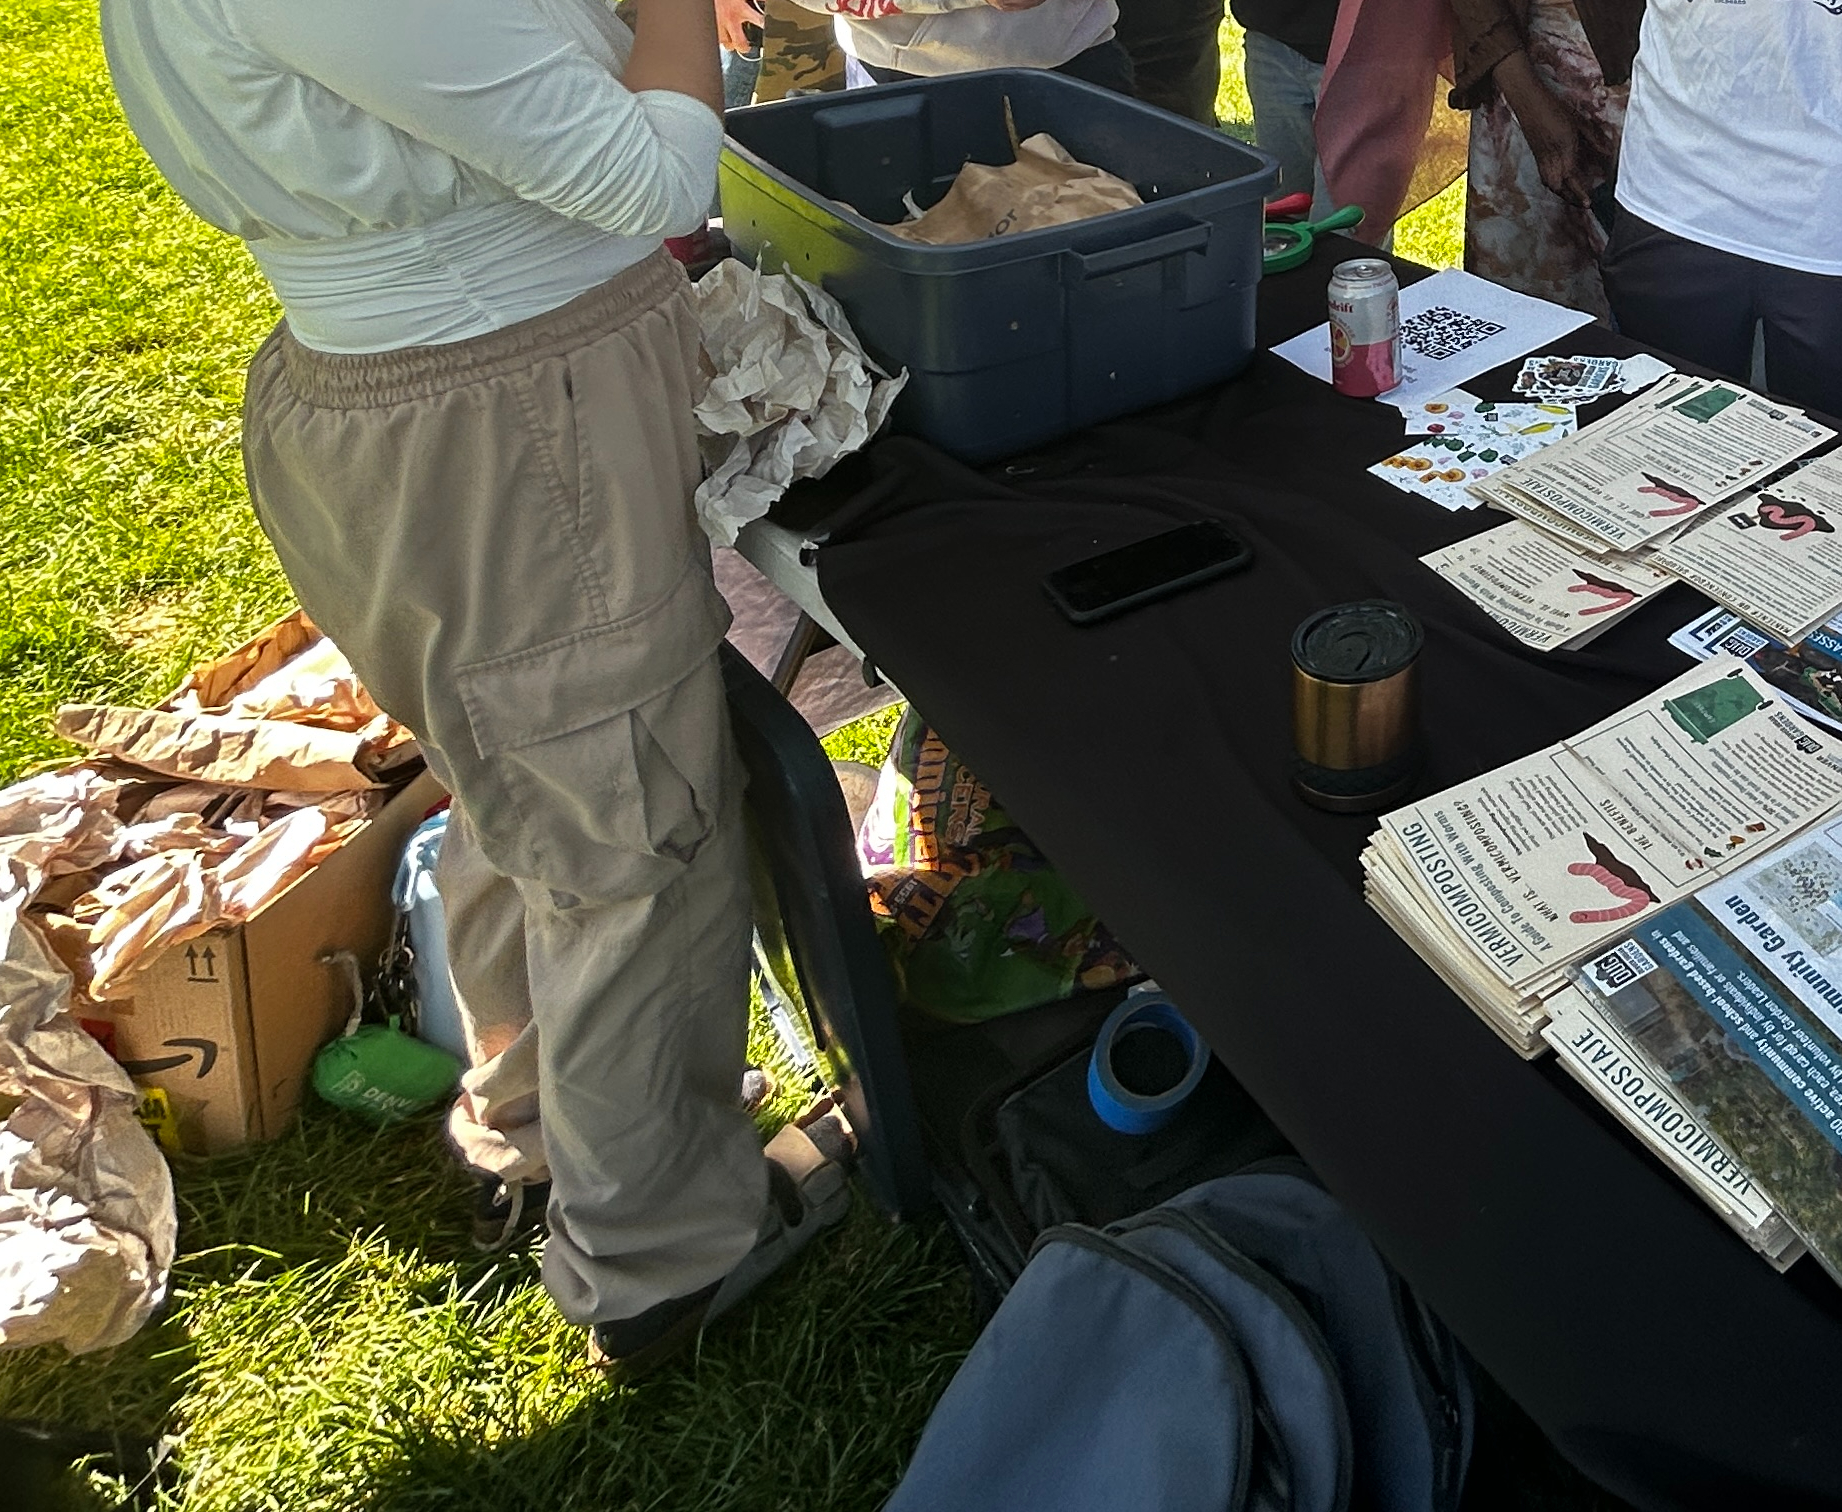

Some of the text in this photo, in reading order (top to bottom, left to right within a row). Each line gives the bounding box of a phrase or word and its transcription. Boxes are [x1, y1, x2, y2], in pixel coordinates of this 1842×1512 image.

[1510, 478, 1636, 538] VERMICOMPOSTAJE
[1599, 799, 1652, 850] THE BENEFITS
[1453, 801, 1520, 882] VERMICOMPOSTING?
[1396, 823, 1529, 965] VERMICOMPOSTING
[1434, 810, 1553, 951] A Guide To Composting With Worms
[1533, 901, 1558, 921] WHAT
[1725, 895, 1784, 951] Garden
[1651, 929, 1662, 940] in
[1671, 930, 1690, 944] and
[1659, 937, 1694, 969] gardens
[1687, 944, 1716, 974] families
[1601, 956, 1631, 983] DUG
[1713, 973, 1726, 982] or
[1686, 969, 1743, 1024] school-based
[1723, 981, 1764, 1022] individuals
[1736, 970, 1767, 1003] Leaders.
[1760, 1020, 1775, 1034] by
[1765, 1000, 1794, 1030] Garden
[1737, 1022, 1758, 1039] and
[1771, 1031, 1787, 1045] for
[1782, 1043, 1809, 1067] cared
[1792, 1028, 1830, 1066] volunteer
[1755, 1038, 1805, 1088] community
[1807, 1066, 1829, 1088] each
[1828, 1064, 1842, 1079] by
[1573, 1030, 1759, 1192] VERMICOMPOSTAJE
[1804, 1088, 1834, 1118] active
